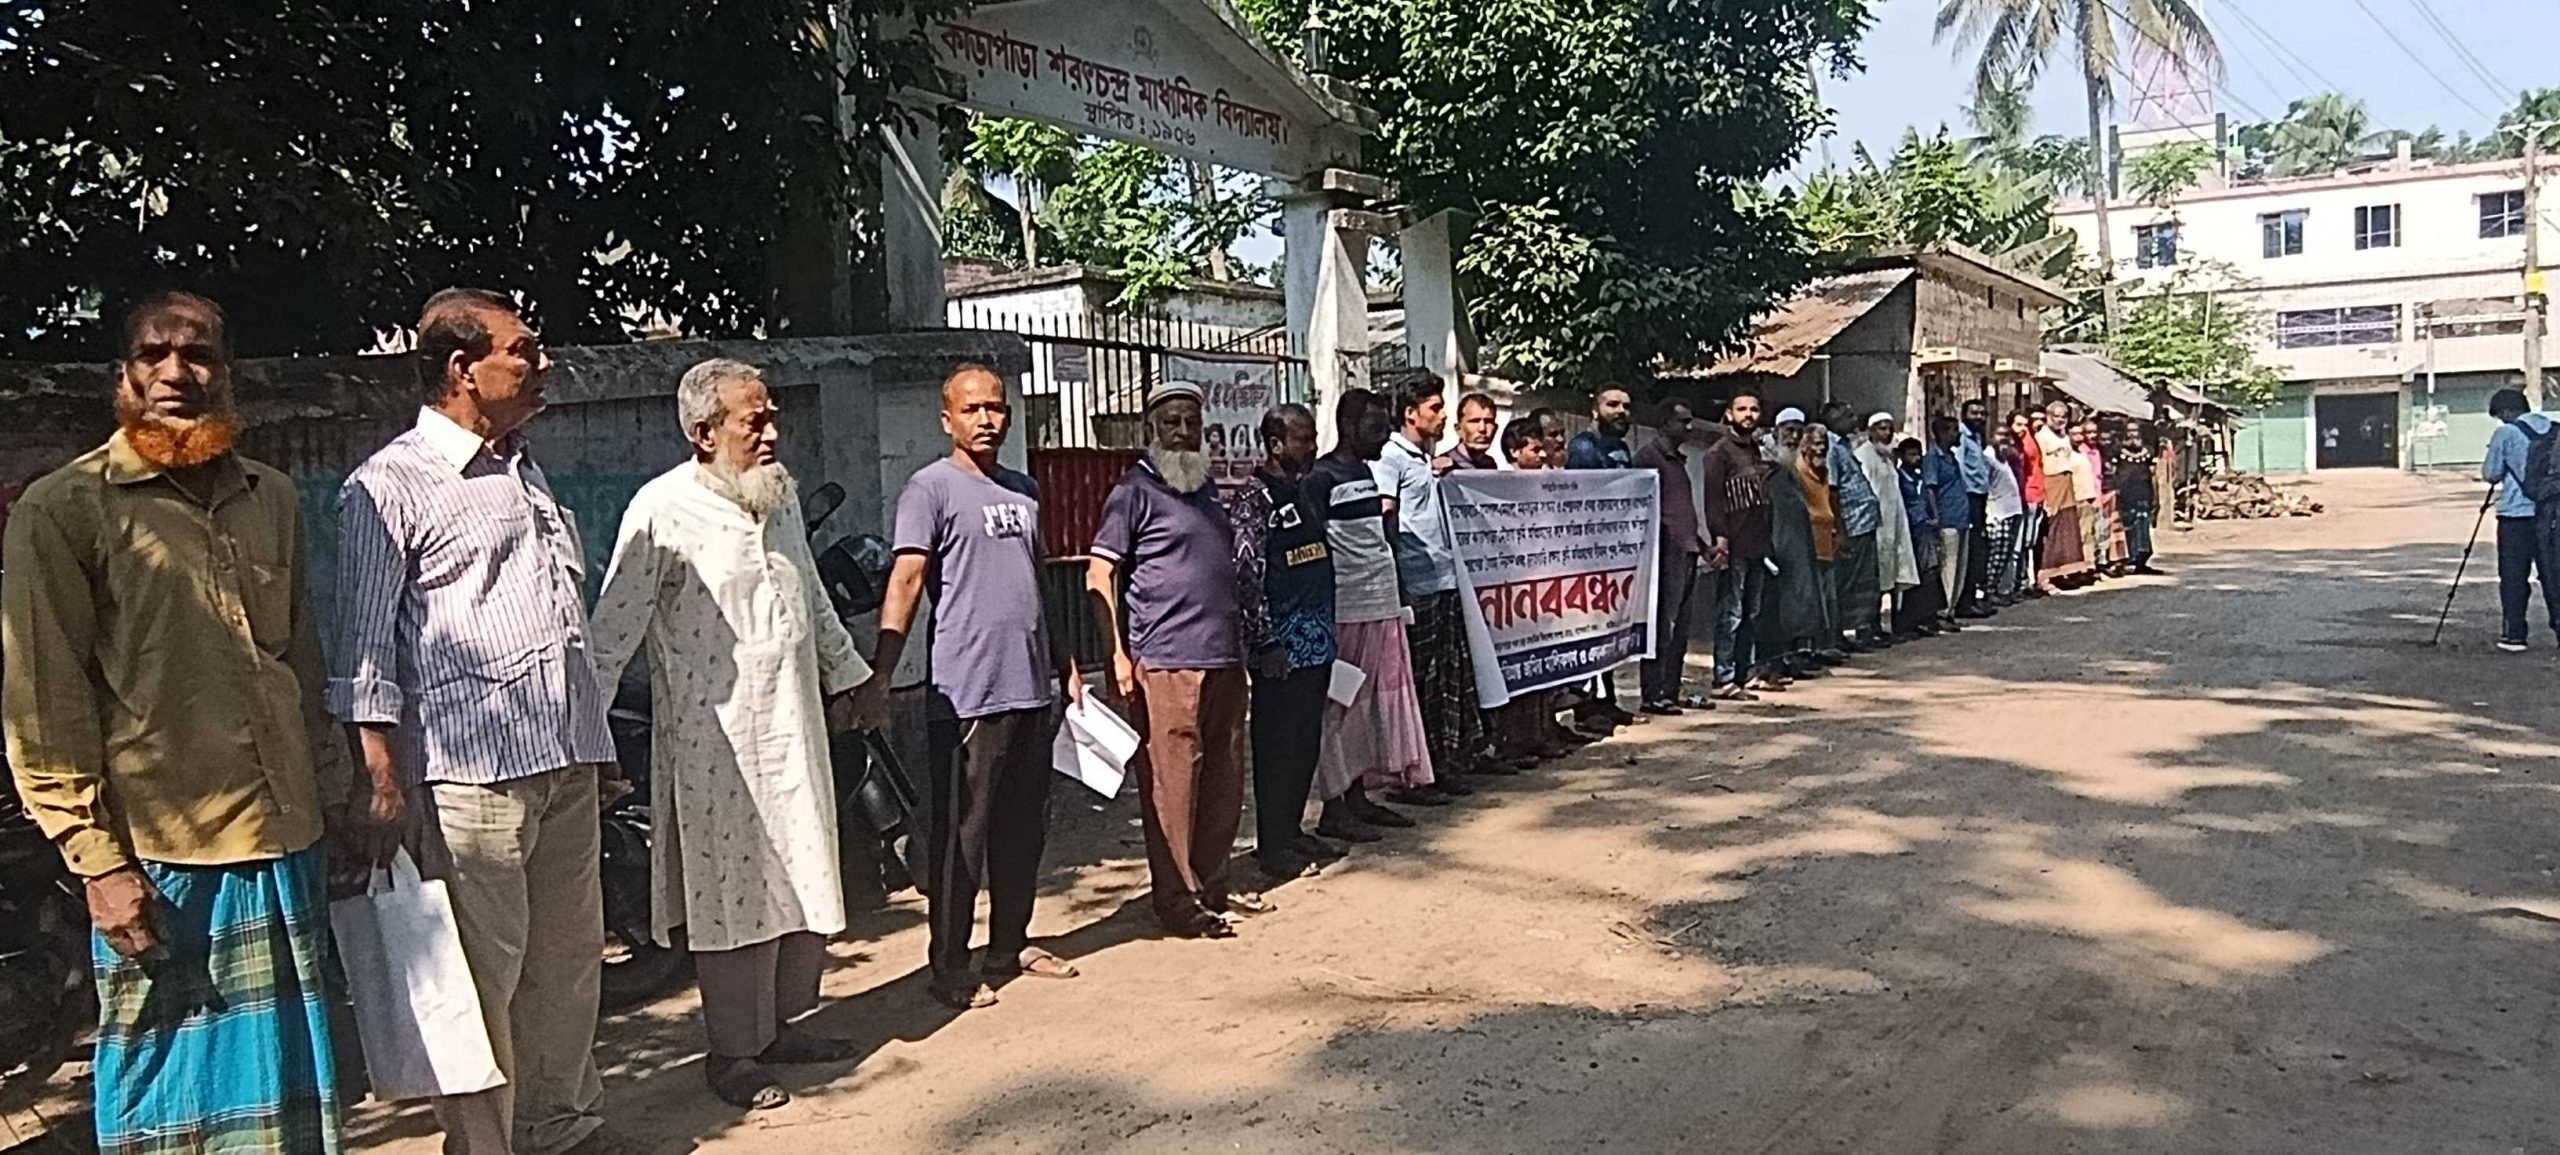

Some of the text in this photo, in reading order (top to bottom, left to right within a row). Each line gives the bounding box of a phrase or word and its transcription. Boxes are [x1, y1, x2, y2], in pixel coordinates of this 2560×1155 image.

[941, 23, 1038, 91] কাড়াপাড়া
[1046, 43, 1130, 104] শরৎচন্দ্র
[1135, 73, 1208, 123] মাধ্যমিক
[1084, 100, 1135, 132] স্থাপিত
[1149, 120, 1198, 147] ১৯০৬
